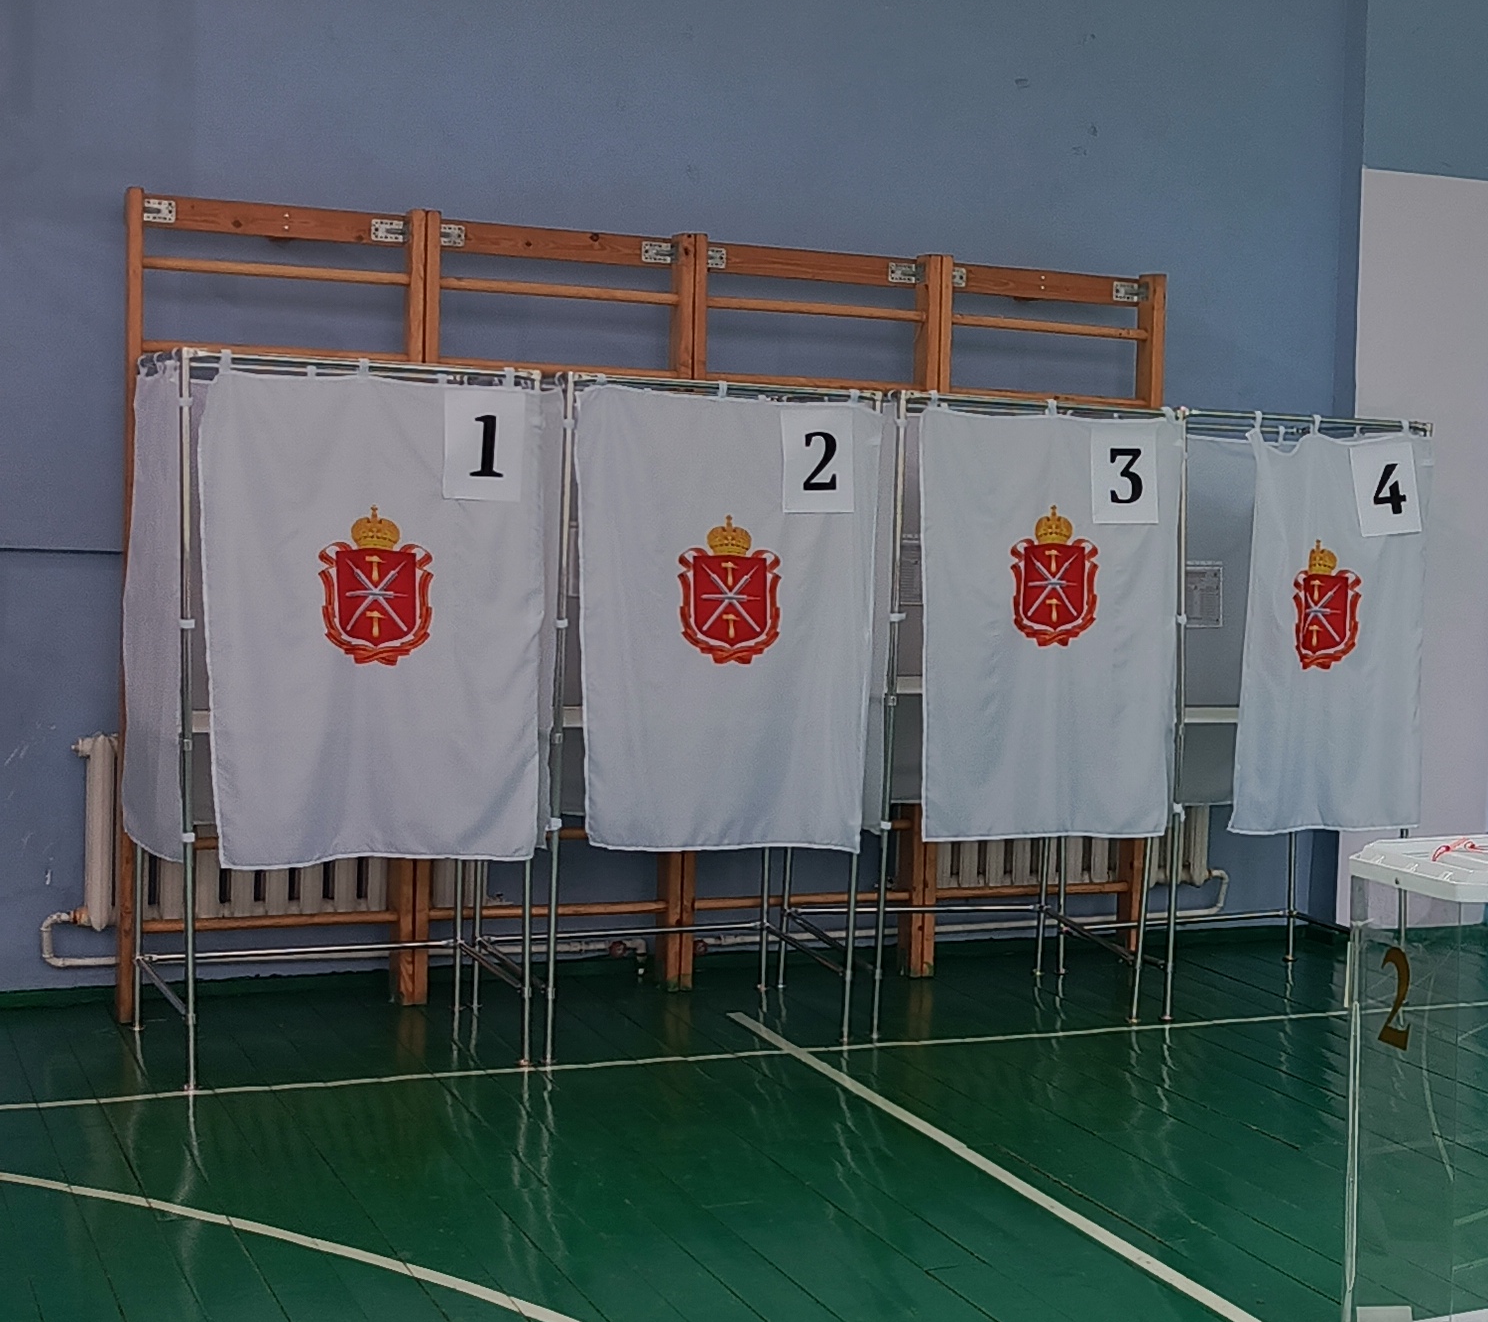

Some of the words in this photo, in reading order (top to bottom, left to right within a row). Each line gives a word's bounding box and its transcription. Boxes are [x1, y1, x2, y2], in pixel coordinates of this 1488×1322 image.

[469, 414, 504, 478] 1
[802, 431, 837, 491] 2
[1109, 447, 1143, 504] 3
[1373, 463, 1407, 515] 4
[1377, 946, 1411, 1052] 2
